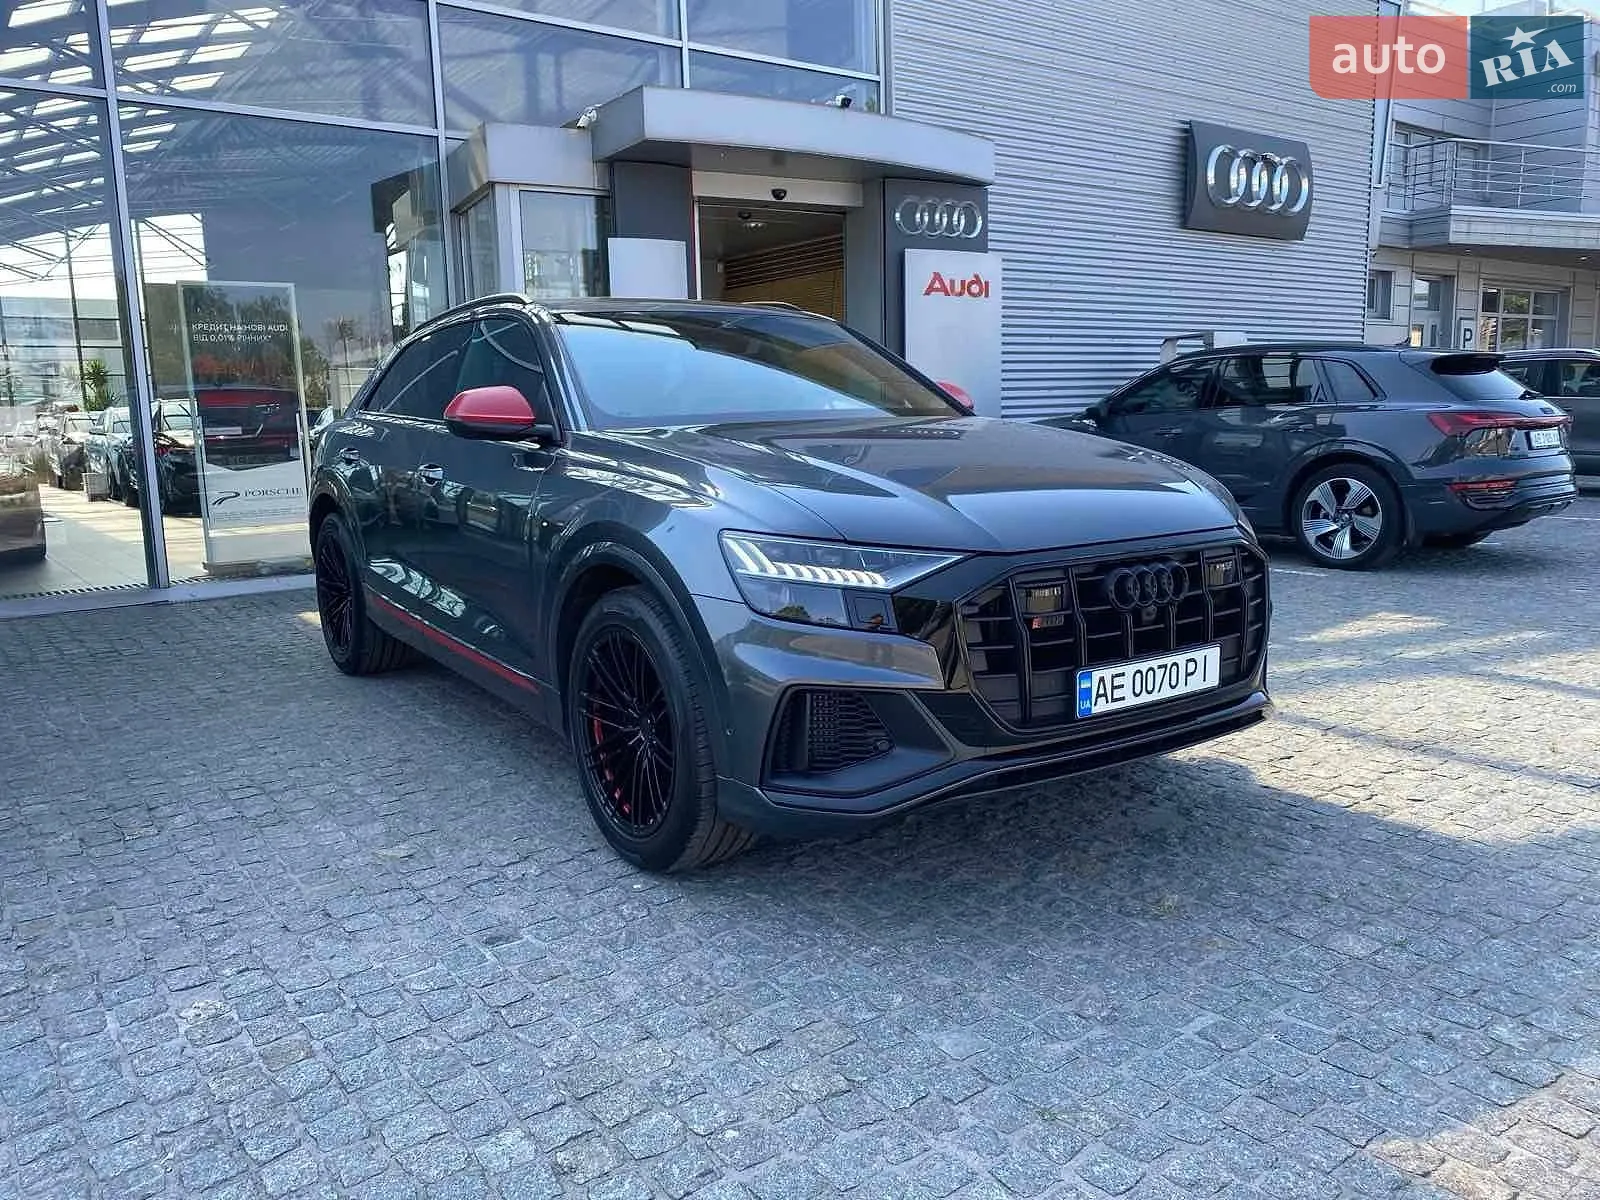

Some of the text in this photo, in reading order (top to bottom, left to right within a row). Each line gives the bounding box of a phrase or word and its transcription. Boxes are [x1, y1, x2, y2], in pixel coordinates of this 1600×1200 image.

[923, 271, 990, 298] Audi
[192, 323, 229, 333] КРЕДИТ
[1463, 327, 1473, 348] P
[1094, 672, 1126, 706] AE
[1132, 661, 1179, 697] 0070
[1080, 701, 1092, 710] UA
